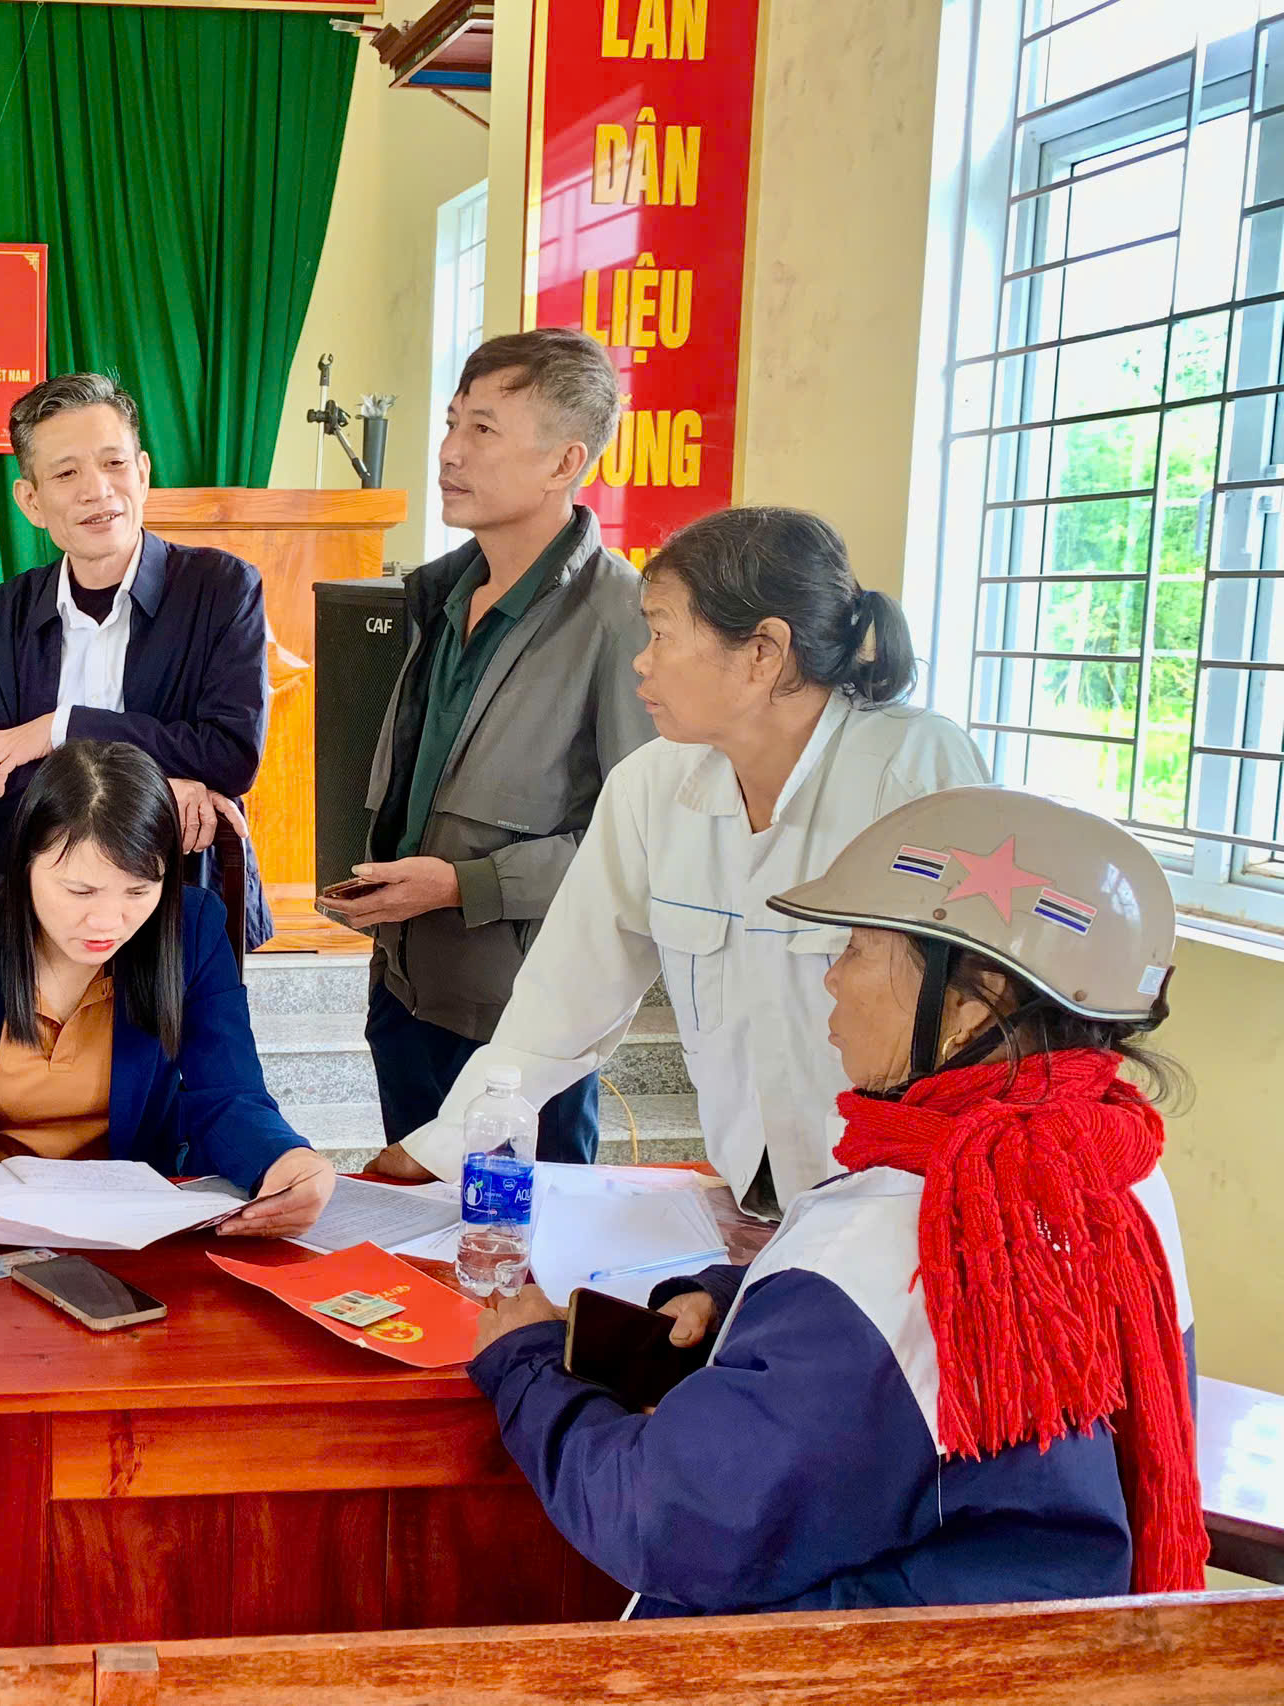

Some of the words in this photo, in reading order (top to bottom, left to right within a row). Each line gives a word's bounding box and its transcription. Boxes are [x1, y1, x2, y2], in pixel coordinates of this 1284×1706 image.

[591, 107, 701, 206] DÂN
[583, 252, 693, 363] LIỆU
[8, 369, 30, 383] NAM
[579, 394, 702, 487] ŨNG
[365, 617, 393, 634] CAF
